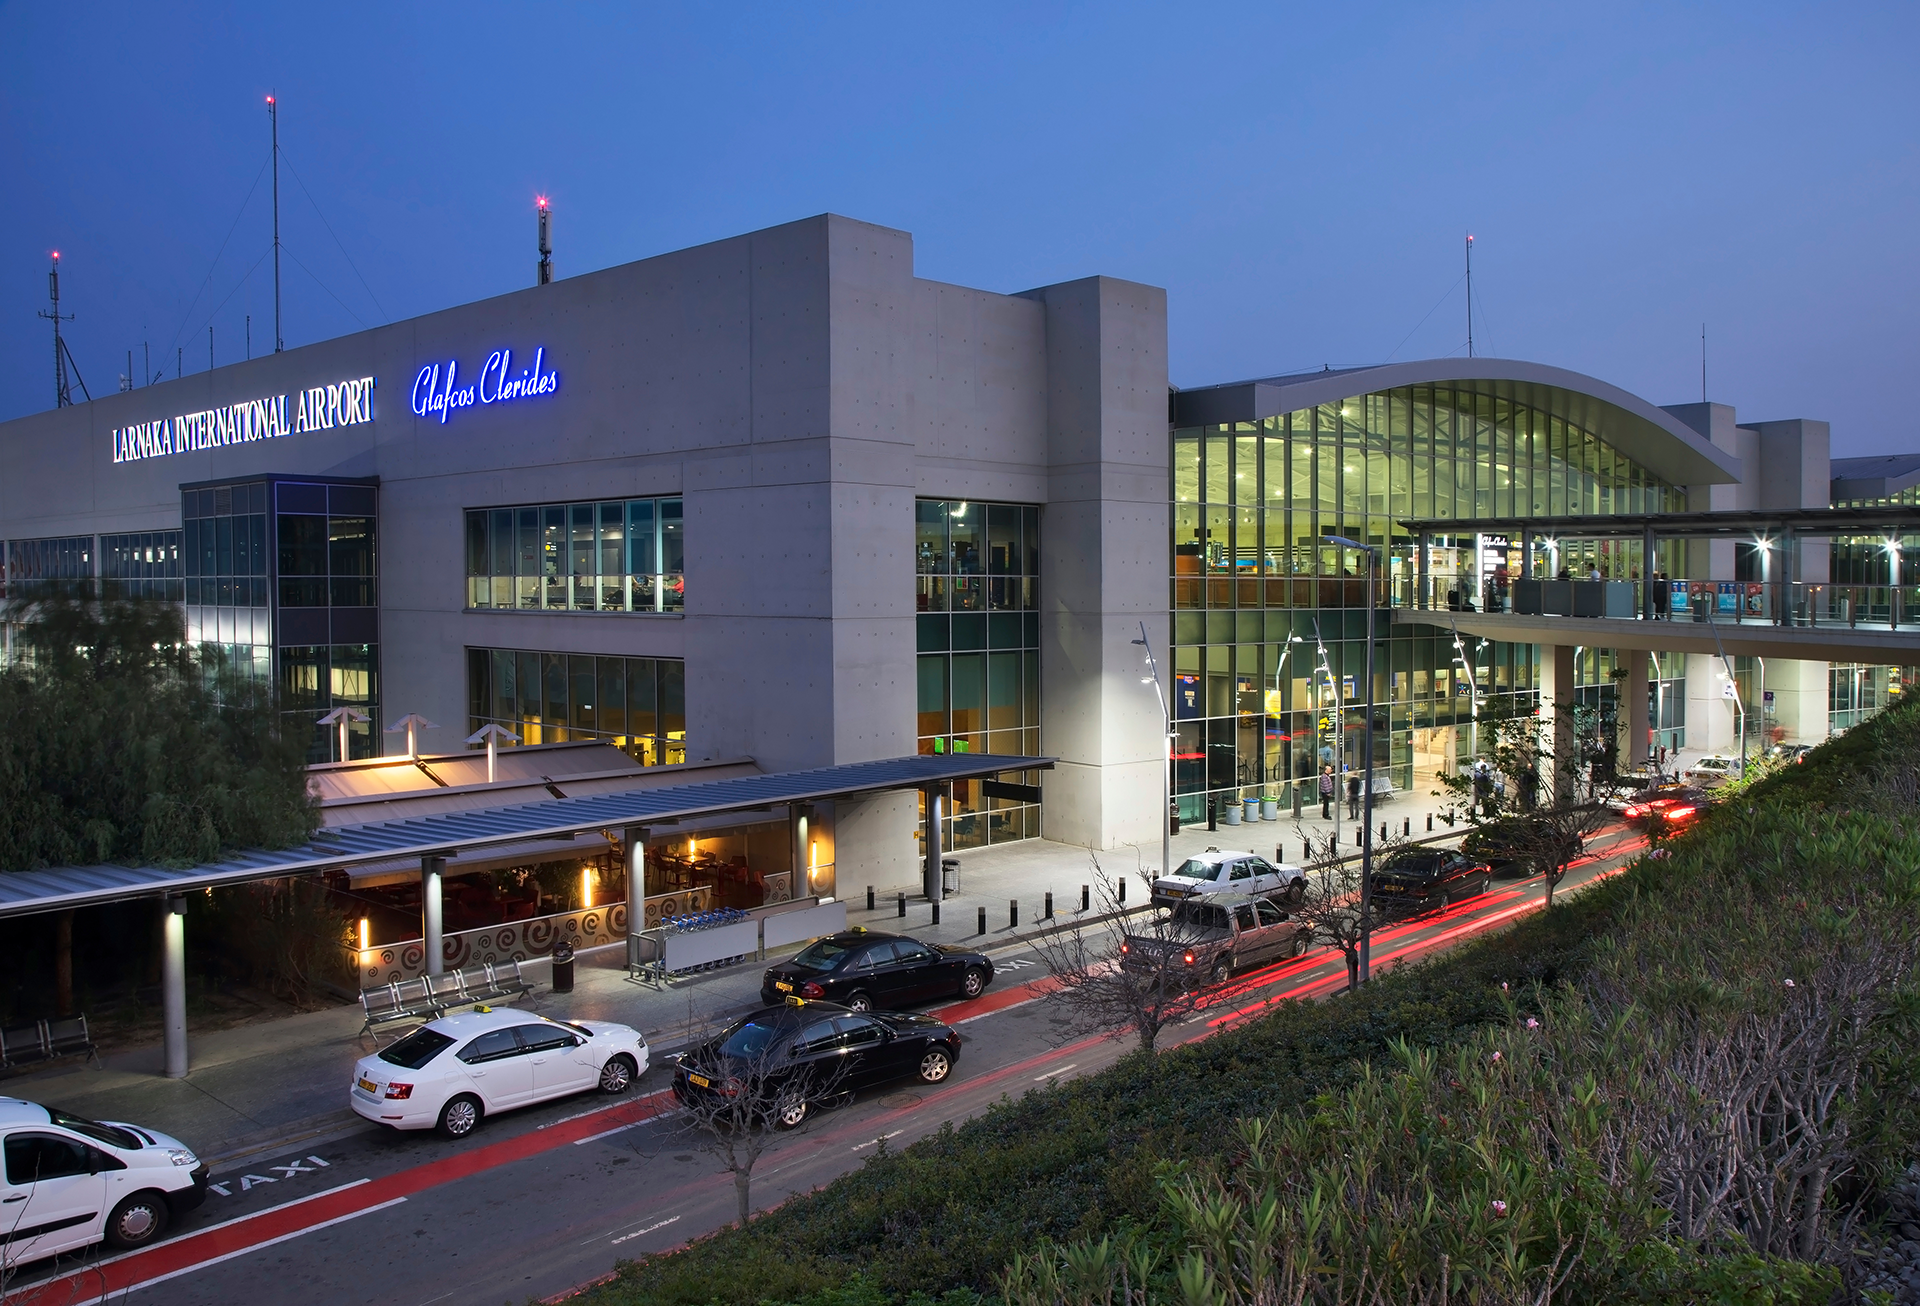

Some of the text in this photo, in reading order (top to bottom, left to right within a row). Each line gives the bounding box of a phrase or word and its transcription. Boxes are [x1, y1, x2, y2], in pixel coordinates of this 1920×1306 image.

[411, 347, 557, 424] Glafcos Clerides
[112, 376, 376, 463] LARNAKA INTERNATIONAL AIRPORT
[994, 959, 1036, 975] AXI
[208, 1155, 331, 1196] TAXI
